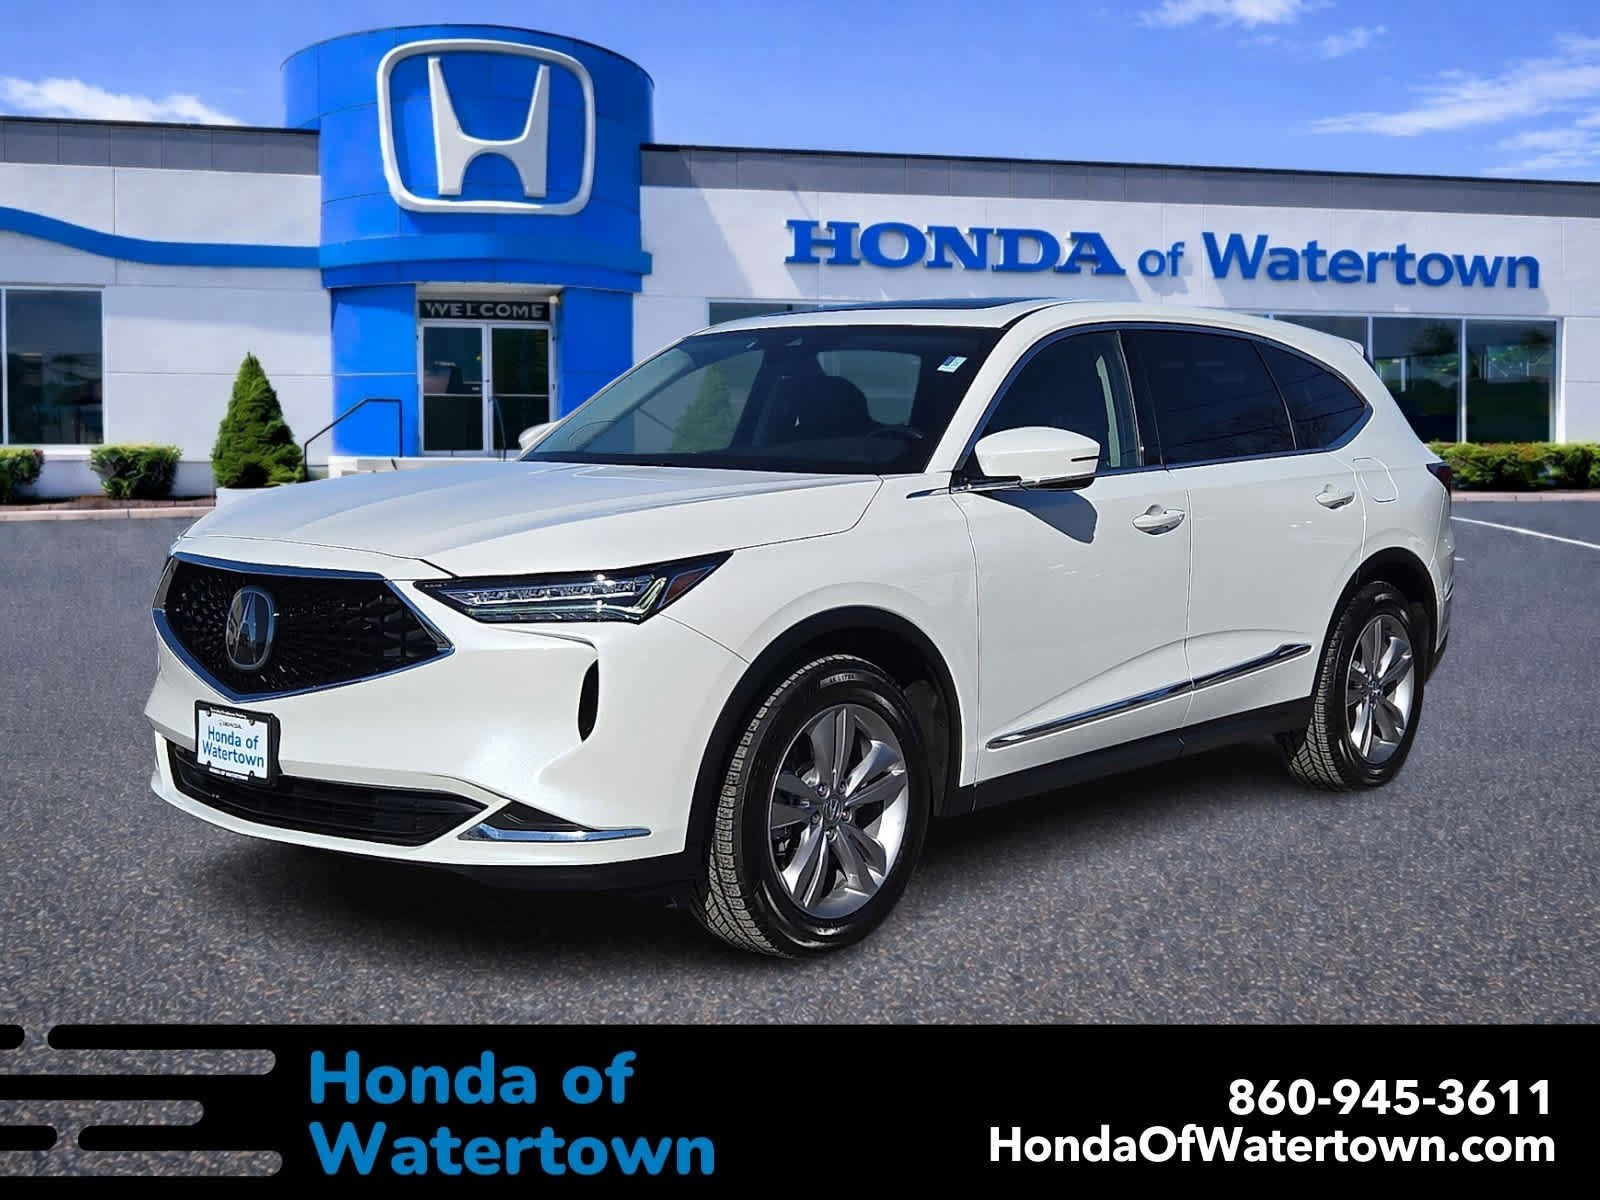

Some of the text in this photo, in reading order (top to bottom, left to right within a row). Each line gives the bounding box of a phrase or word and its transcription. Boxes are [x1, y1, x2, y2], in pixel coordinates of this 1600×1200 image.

[785, 218, 1540, 289] HONDA of Watertown
[424, 301, 545, 319] WELCOME
[208, 725, 259, 750] Honda of
[203, 740, 264, 768] Watertown
